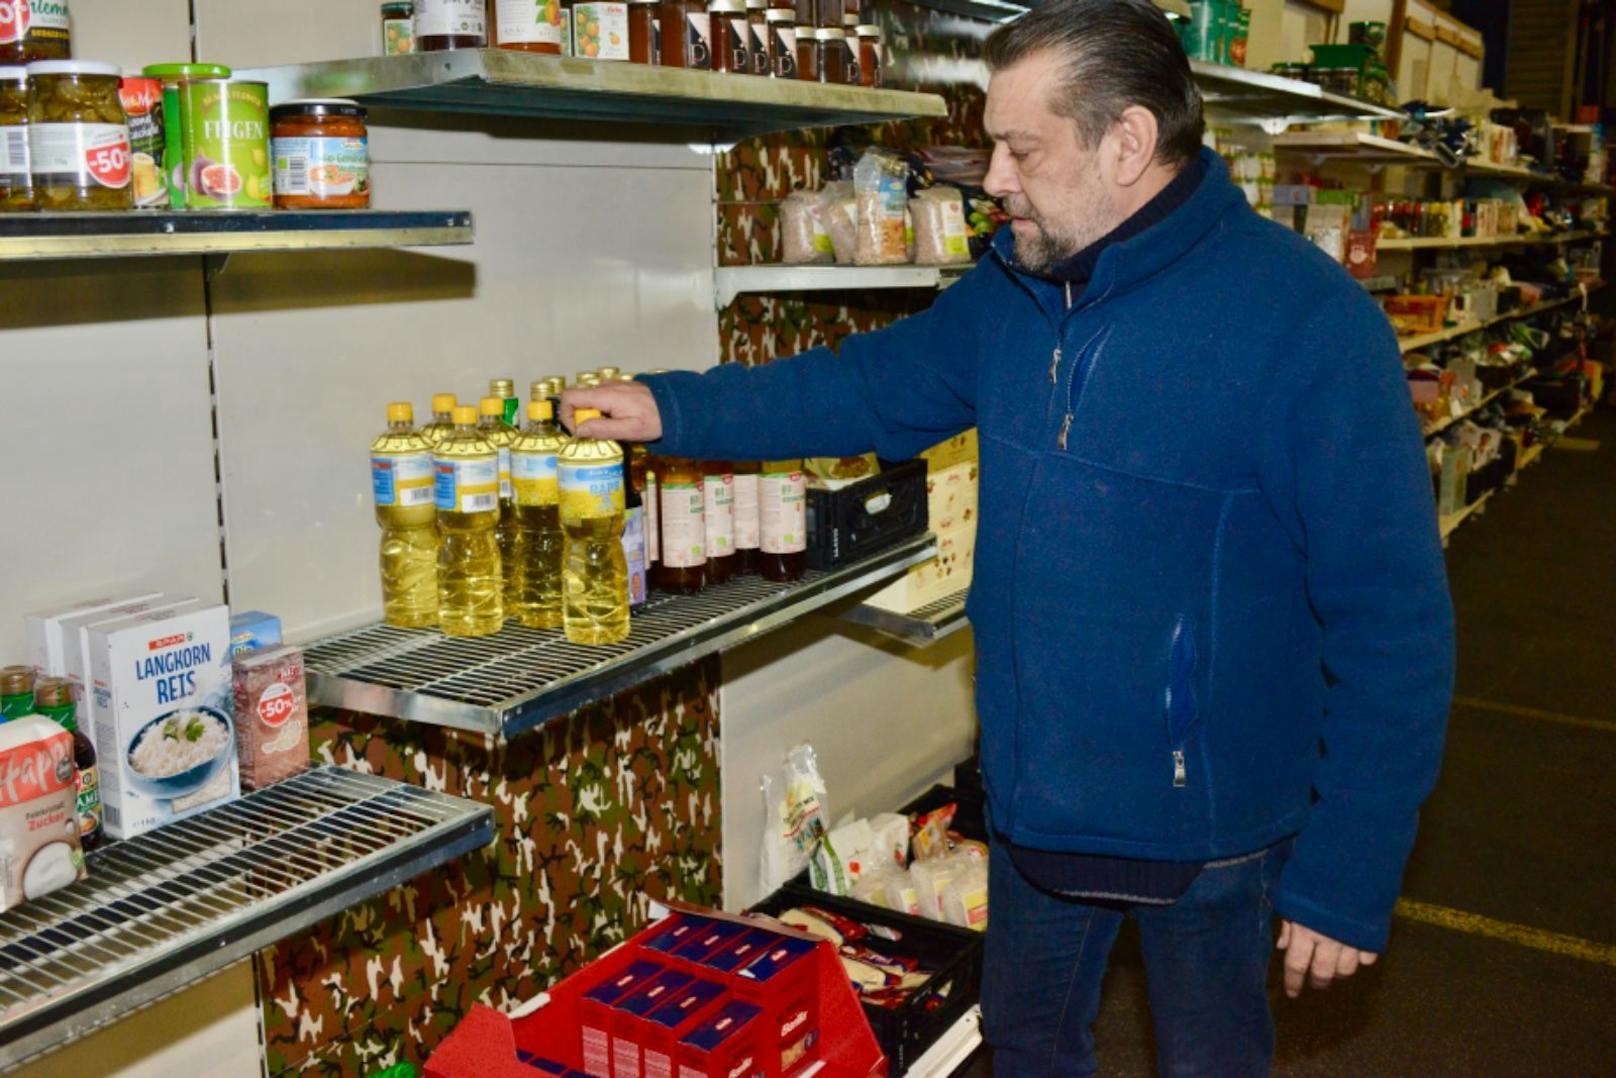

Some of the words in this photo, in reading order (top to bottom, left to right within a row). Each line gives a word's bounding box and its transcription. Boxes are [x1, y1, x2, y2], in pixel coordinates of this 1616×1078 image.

[205, 121, 263, 139] FEIGEN
[135, 642, 211, 680] LANGKORN
[157, 670, 196, 704] REIS
